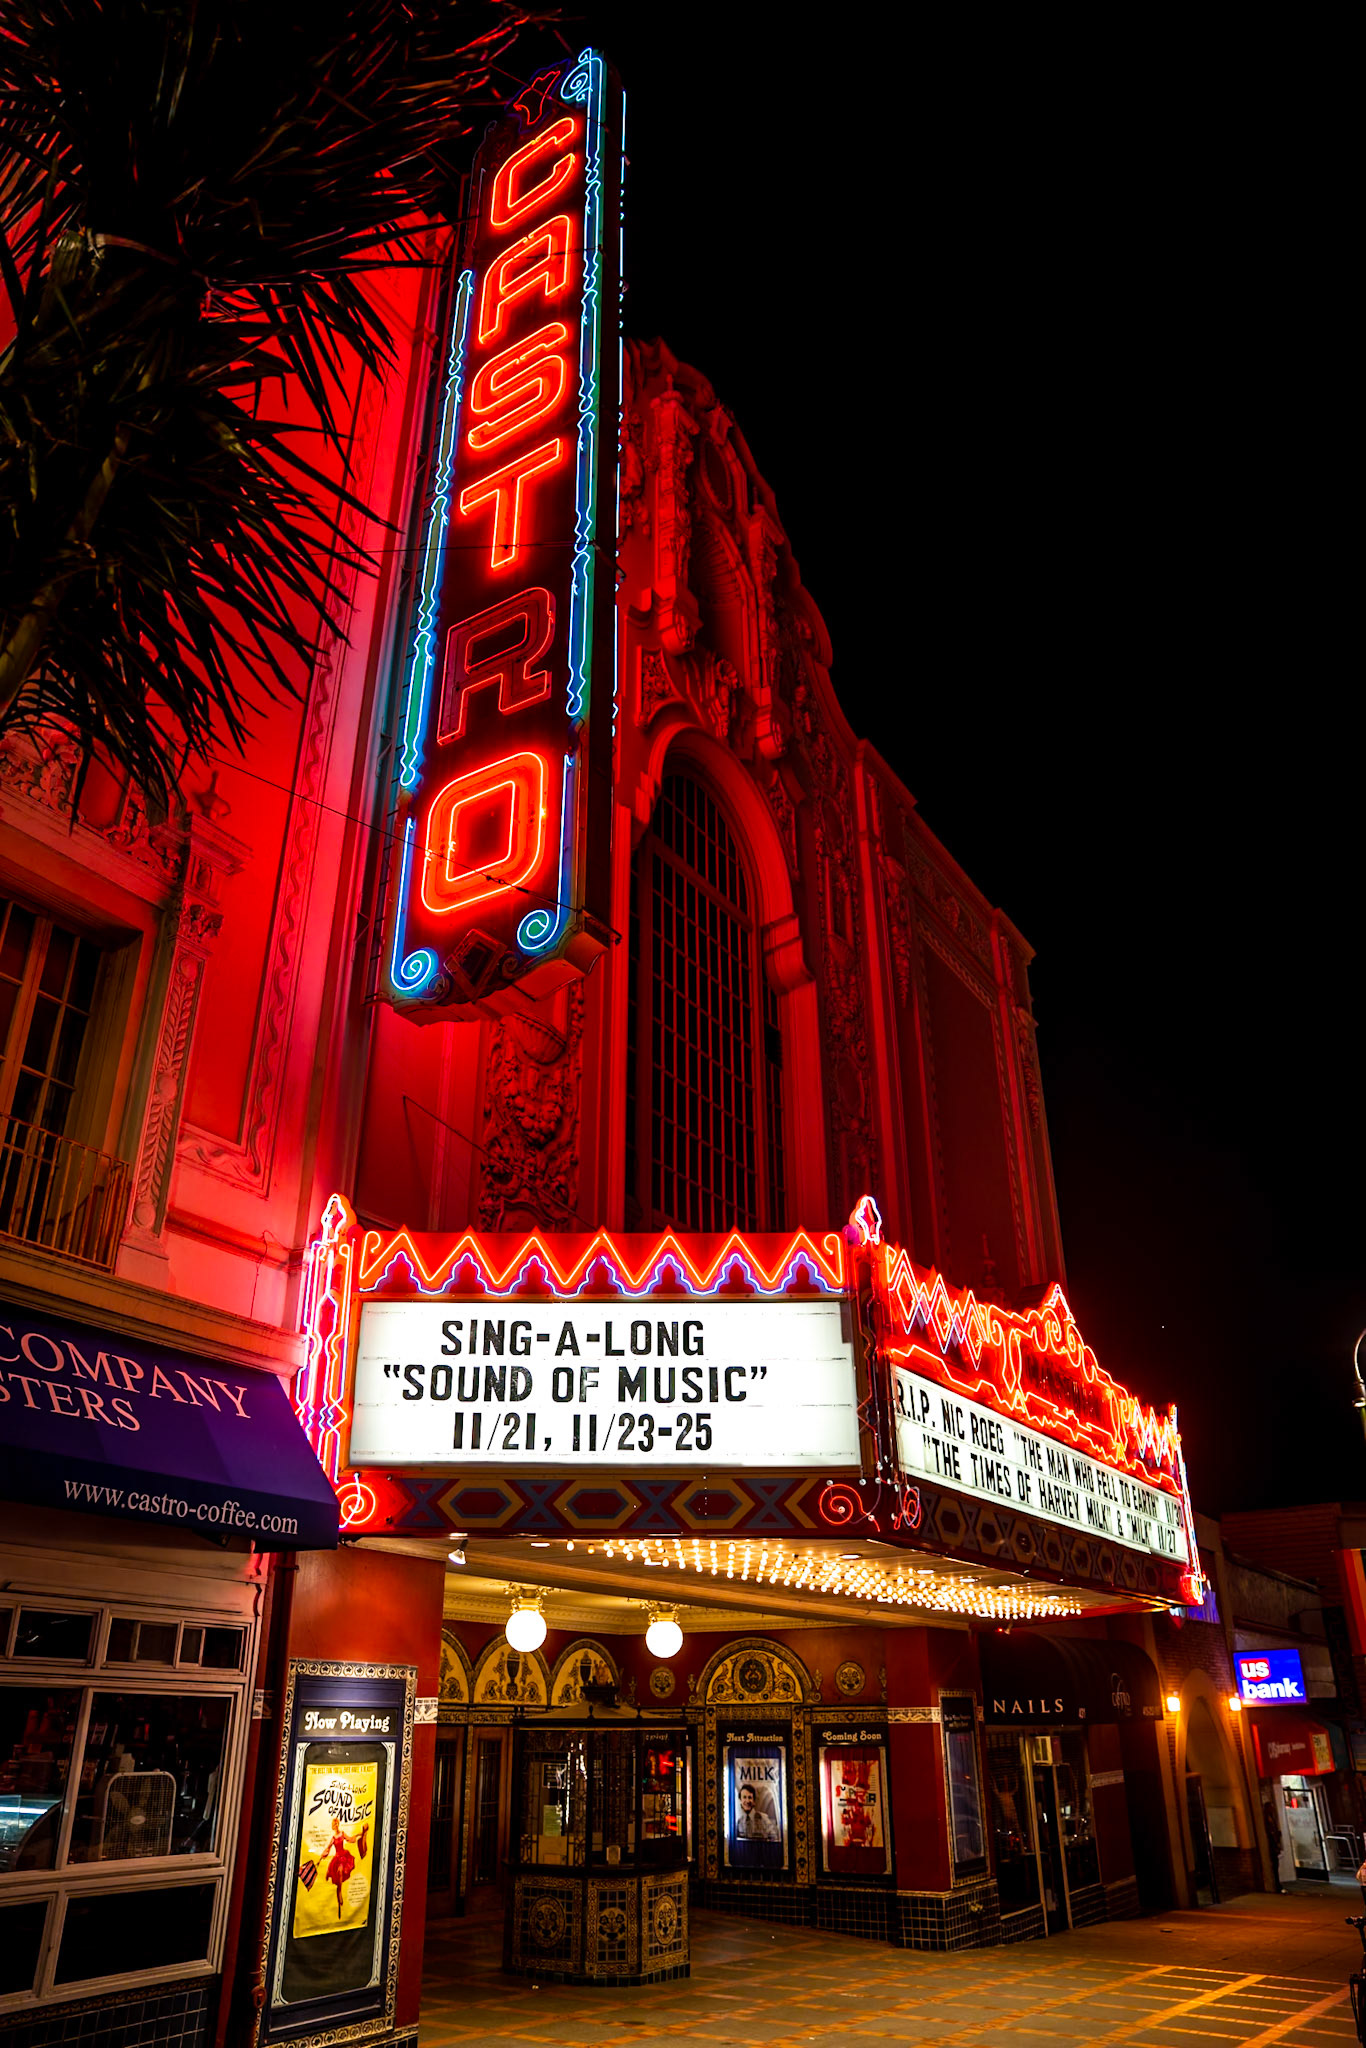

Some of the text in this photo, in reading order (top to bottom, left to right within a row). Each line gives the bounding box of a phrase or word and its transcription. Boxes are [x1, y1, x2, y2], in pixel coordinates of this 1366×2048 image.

[419, 114, 577, 915] CASTRO
[441, 1319, 705, 1357] SING-A-LONG
[383, 1364, 769, 1404] "SOUND OF MUSIC"
[572, 1412, 714, 1452] 11/23-25
[941, 1398, 965, 1441] NIC
[970, 1411, 1005, 1456] ROEG
[1046, 1446, 1071, 1483] MAN
[1072, 1457, 1095, 1493] WHO
[1096, 1468, 1119, 1503] FELL
[1119, 1479, 1131, 1508] TO
[64, 1479, 299, 1535] www.castro-coffee.com
[970, 1452, 1012, 1498] TIMES
[1017, 1469, 1032, 1504] OF
[1038, 1478, 1080, 1521] HARVEY
[1116, 1509, 1124, 1537] &
[1240, 1661, 1270, 1678] us
[993, 1698, 1065, 1715] NAILS
[305, 1711, 391, 1733] Now Playing
[726, 1732, 784, 1743] Next Attraction
[822, 1731, 882, 1743] Coming Soon
[739, 1765, 776, 1782] MILK
[308, 1789, 353, 1816] SOUND
[328, 1806, 339, 1816] OF
